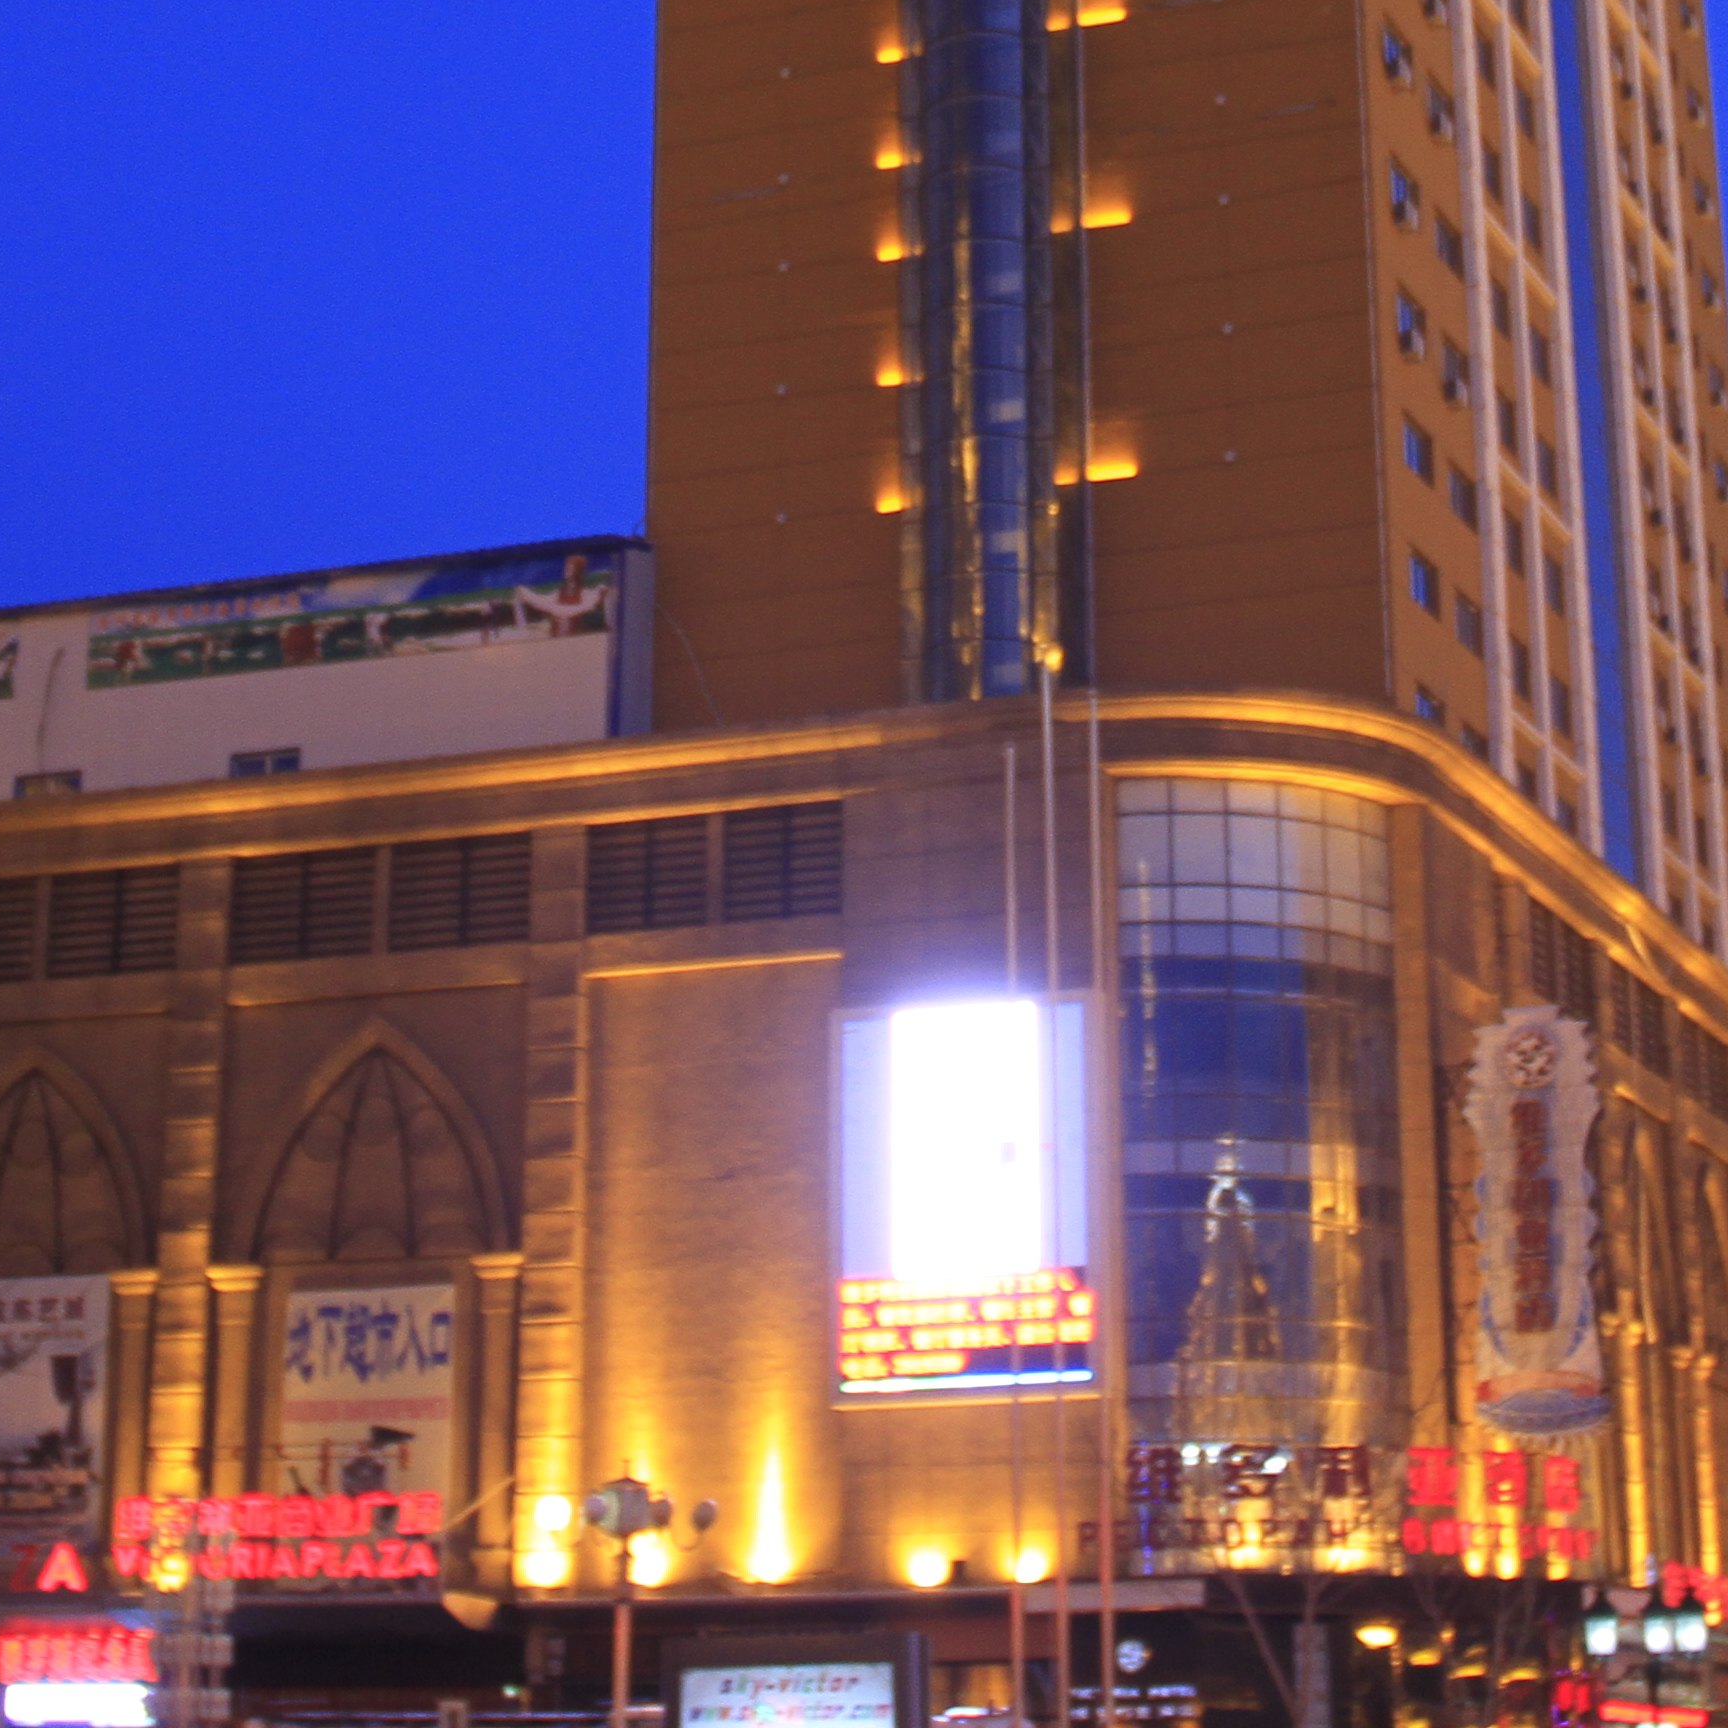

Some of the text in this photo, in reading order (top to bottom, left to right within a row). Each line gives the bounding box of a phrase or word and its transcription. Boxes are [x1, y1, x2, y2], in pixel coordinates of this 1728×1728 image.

[286, 1298, 452, 1383] 地下超市入口
